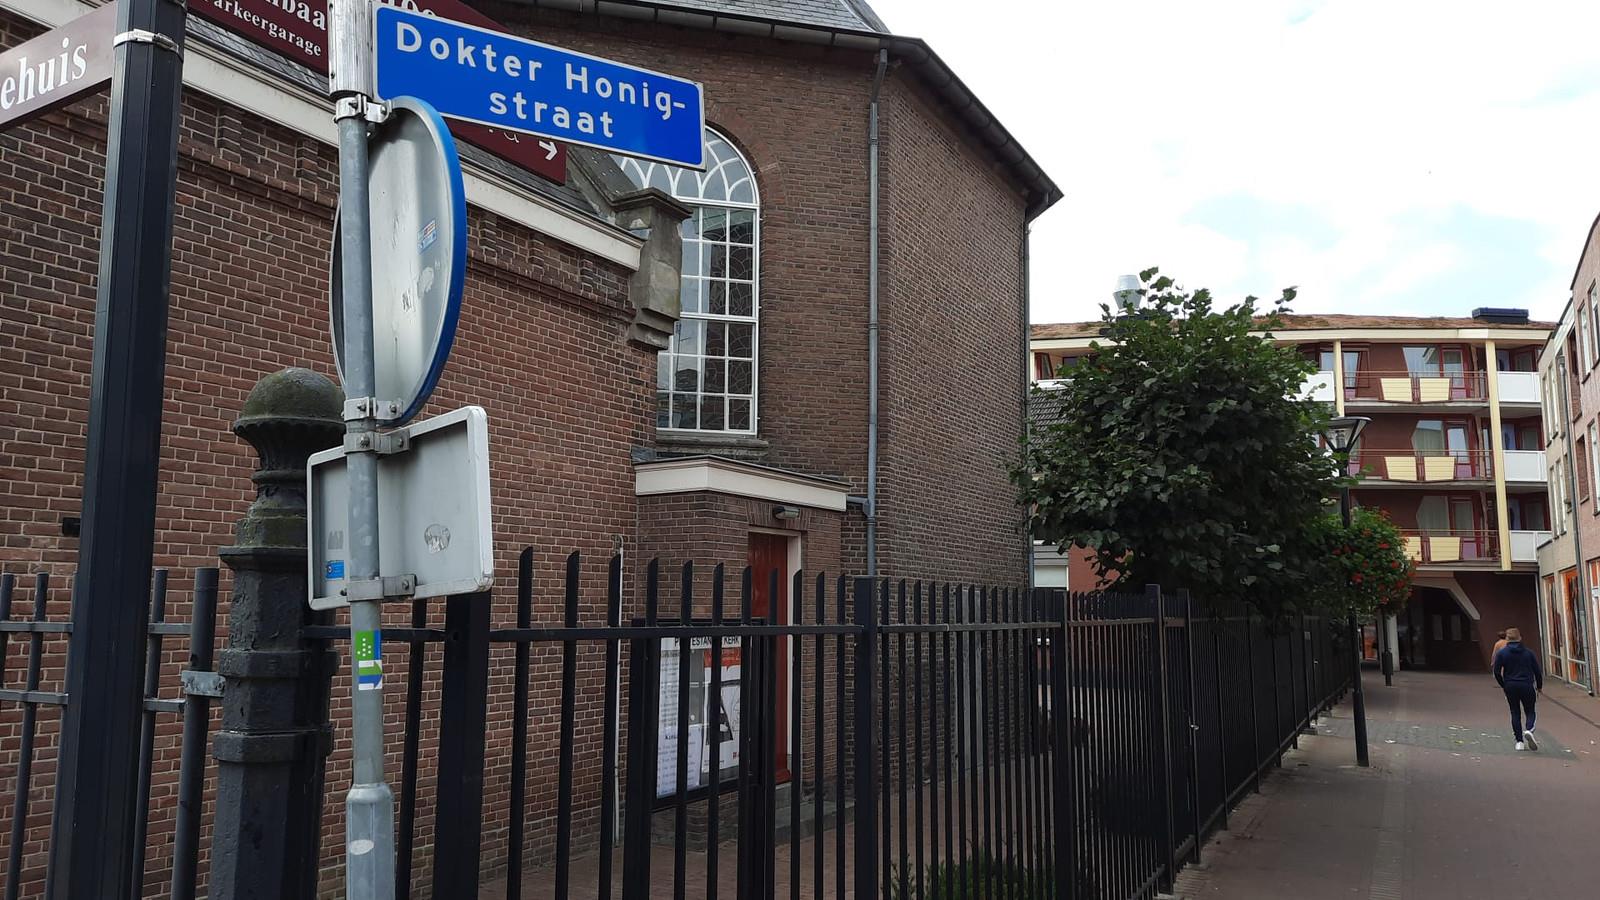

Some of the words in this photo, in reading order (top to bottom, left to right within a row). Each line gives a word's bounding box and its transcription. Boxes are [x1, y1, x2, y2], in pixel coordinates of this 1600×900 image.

[203, 0, 322, 57] arkeergarage
[0, 37, 88, 110] ehuis
[396, 21, 543, 81] Dokter
[565, 62, 686, 120] Honig-
[489, 91, 614, 138] straat
